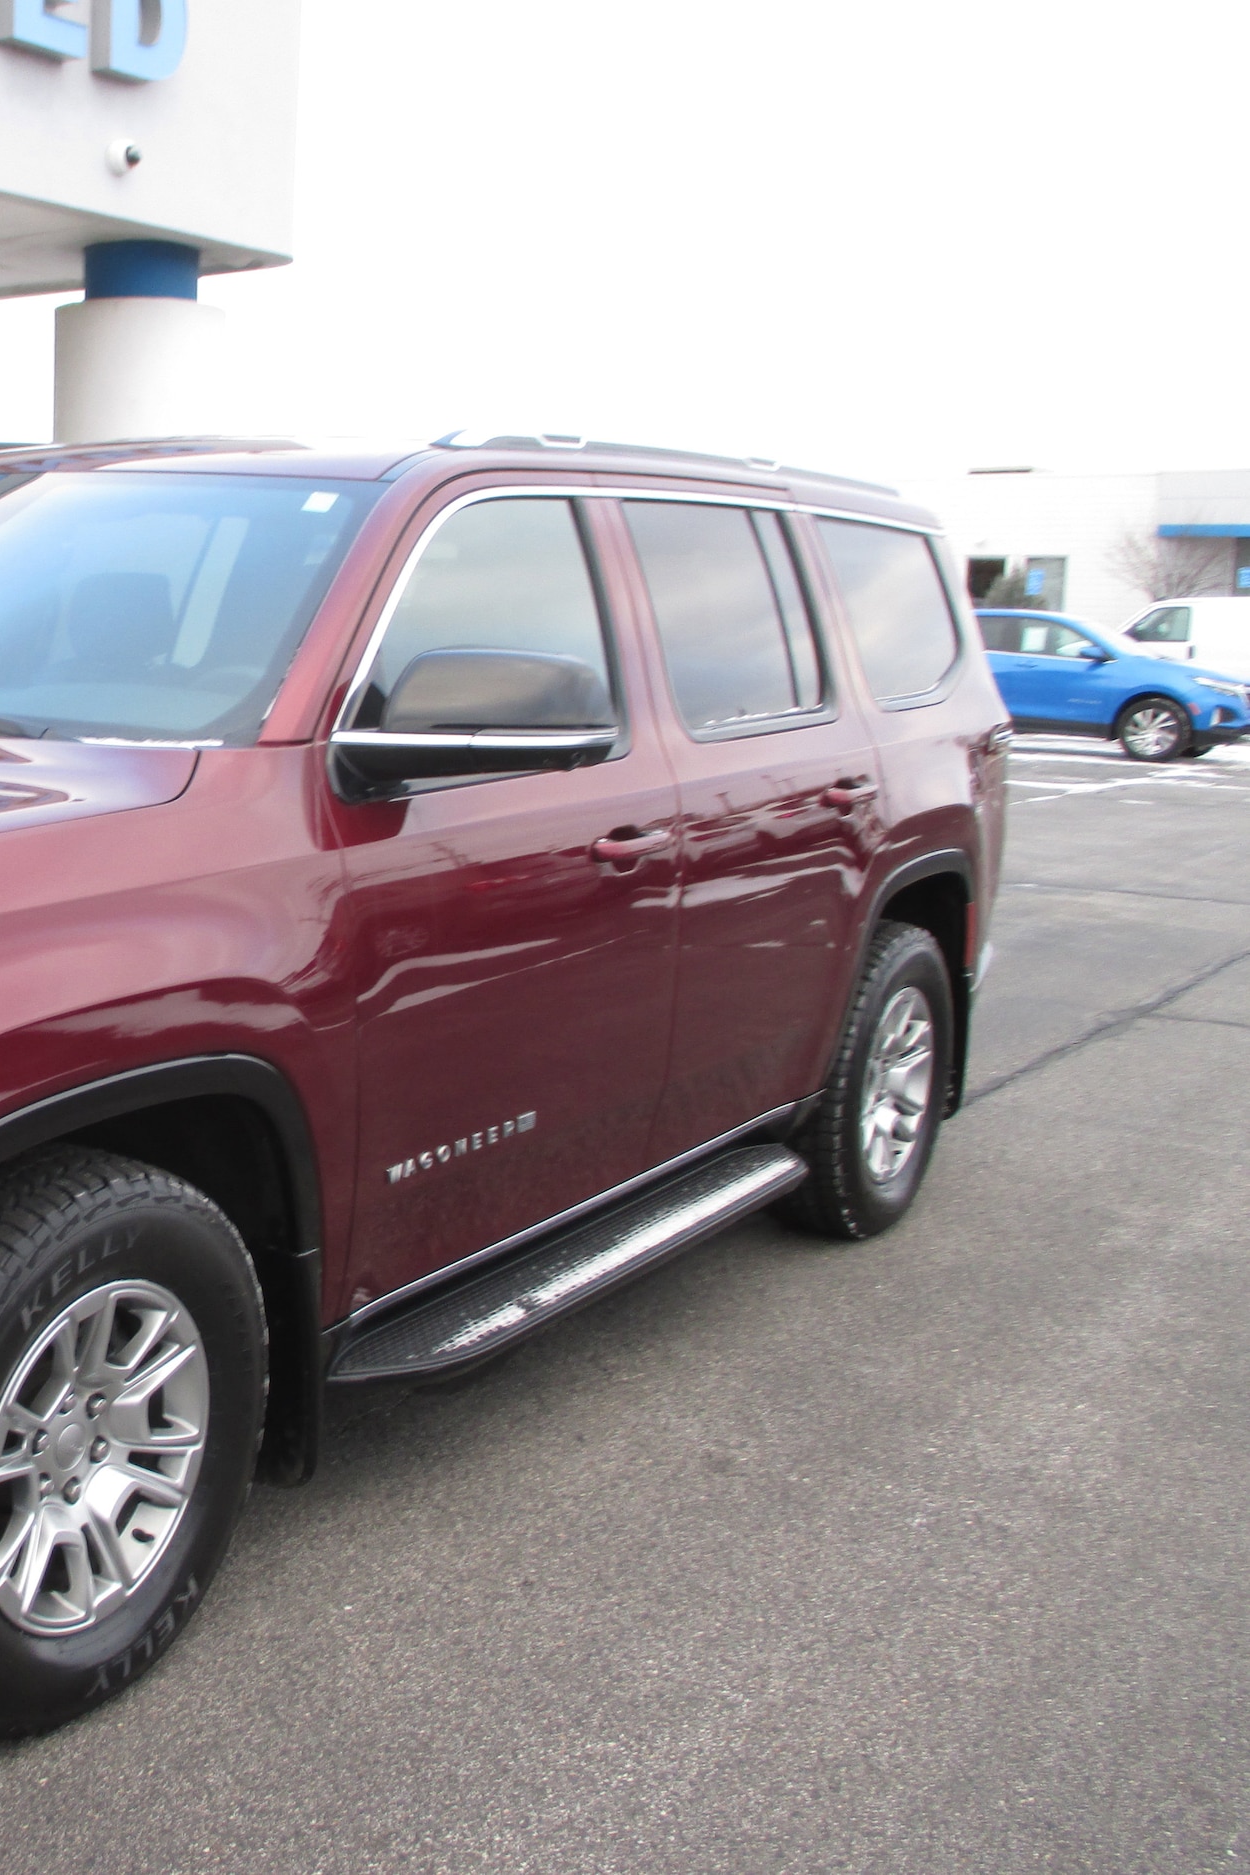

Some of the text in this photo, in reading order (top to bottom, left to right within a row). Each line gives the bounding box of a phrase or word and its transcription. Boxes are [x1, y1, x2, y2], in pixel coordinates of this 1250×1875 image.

[386, 1119, 515, 1185] WAGONEER
[20, 1225, 142, 1331] KELLY
[85, 1572, 198, 1698] KELLY
